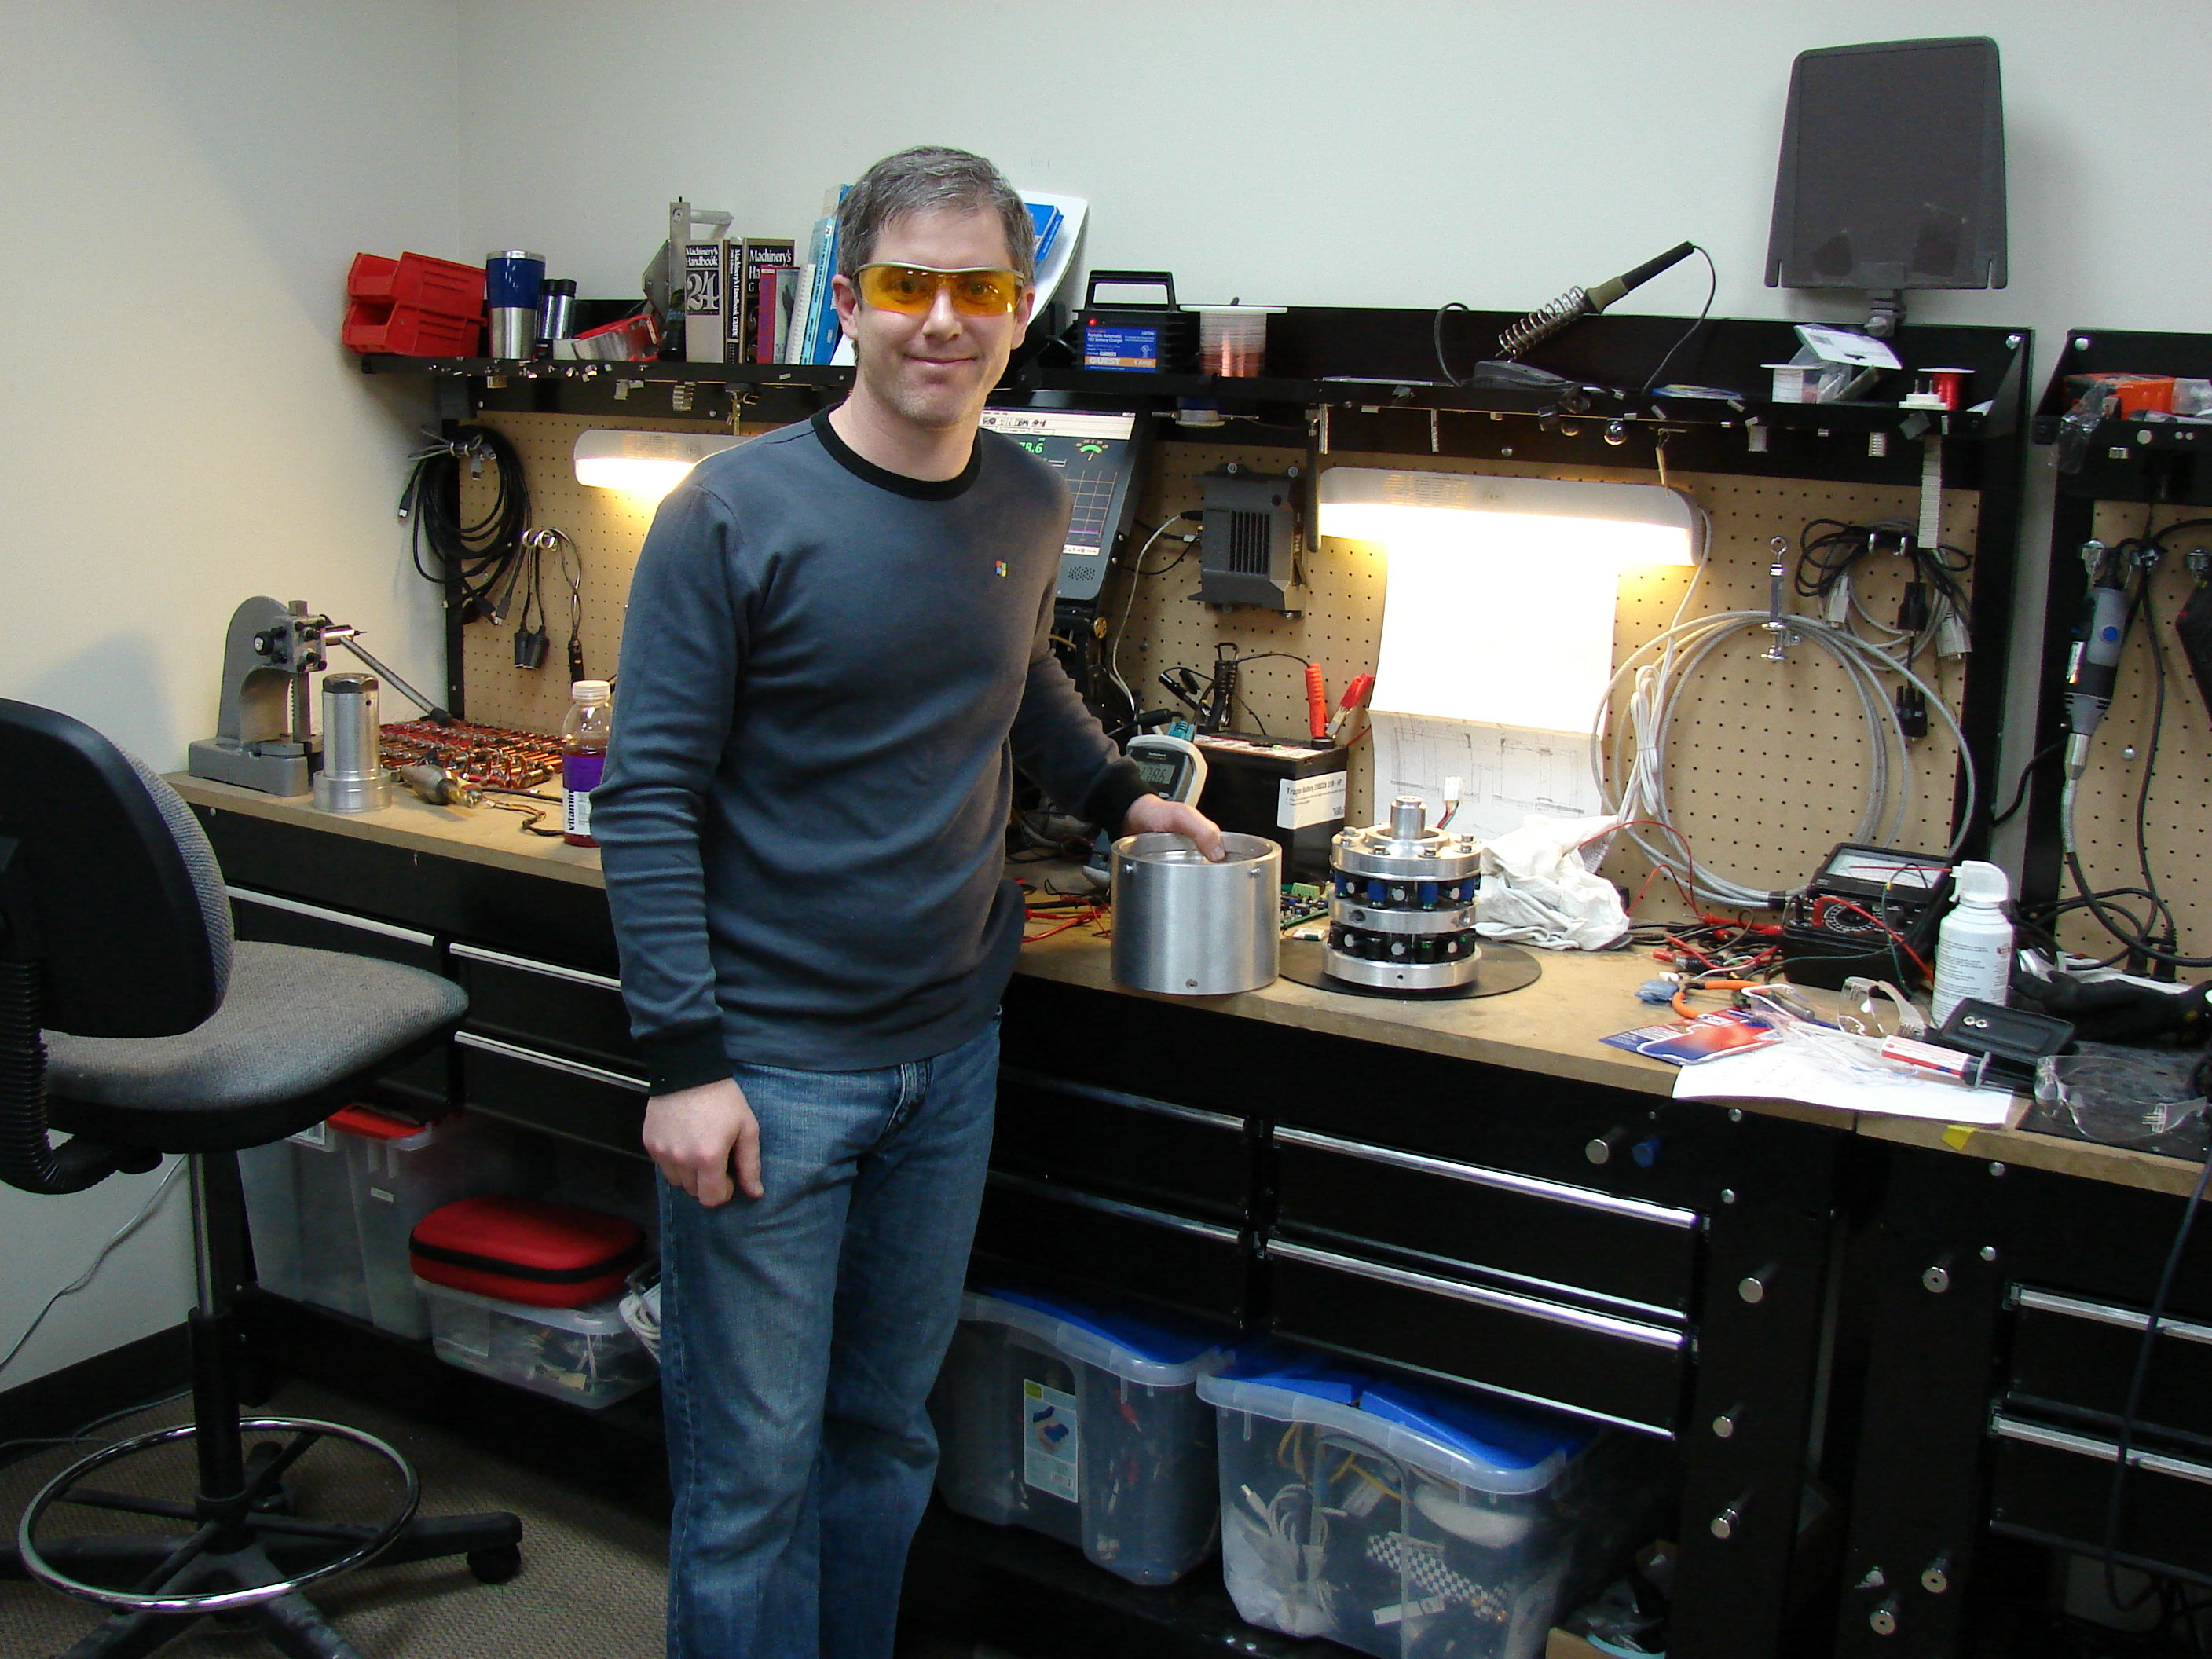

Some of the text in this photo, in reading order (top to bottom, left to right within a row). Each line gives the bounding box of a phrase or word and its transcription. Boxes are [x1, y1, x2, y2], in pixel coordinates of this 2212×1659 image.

[686, 247, 719, 258] Machinery's
[749, 248, 792, 263] Machinery's
[686, 256, 719, 266] Handbook
[732, 248, 742, 284] Machinery's
[687, 271, 720, 311] 24
